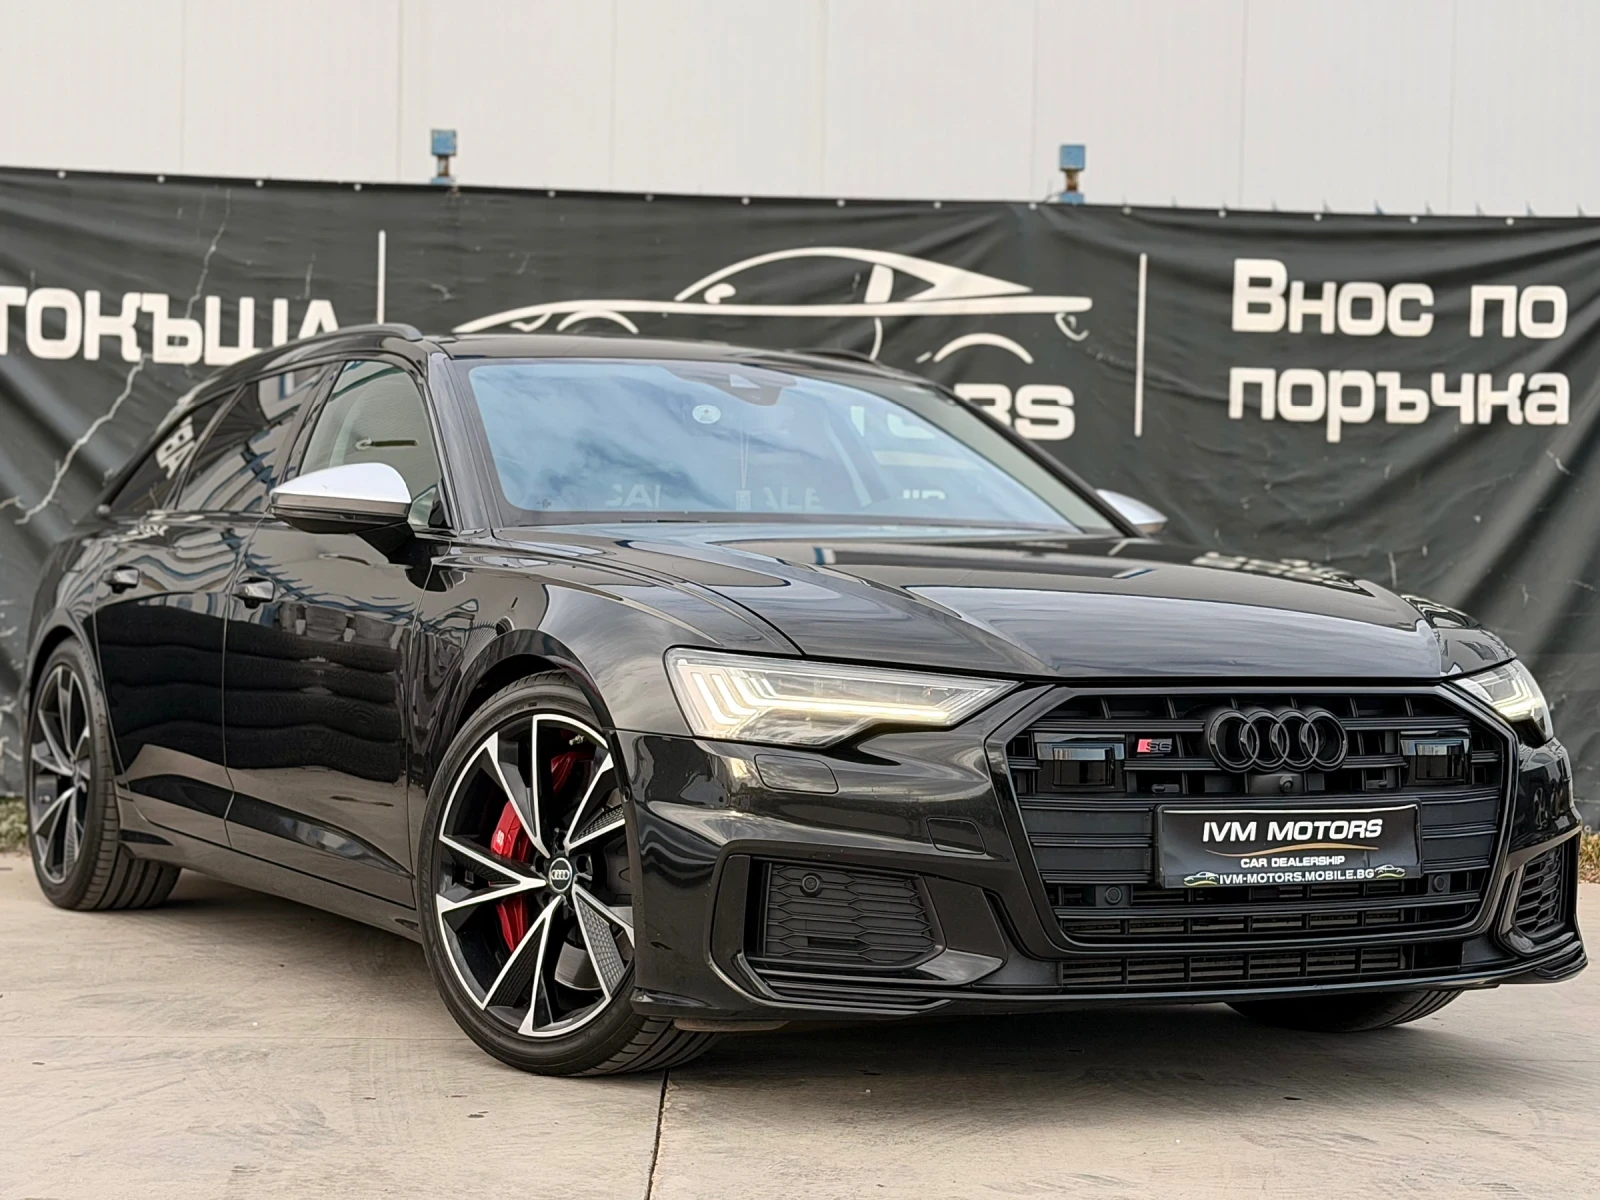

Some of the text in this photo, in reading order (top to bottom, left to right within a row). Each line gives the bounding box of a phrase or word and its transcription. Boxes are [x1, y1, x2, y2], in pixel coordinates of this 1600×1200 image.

[1232, 258, 1567, 338] Внос по
[1228, 367, 1570, 442] поръчка
[1202, 818, 1383, 843] IVM MOTORS
[1240, 855, 1346, 869] CAR DEALERSHIP
[1219, 868, 1375, 885] IVM-MOTORS.MOBILE.BG
